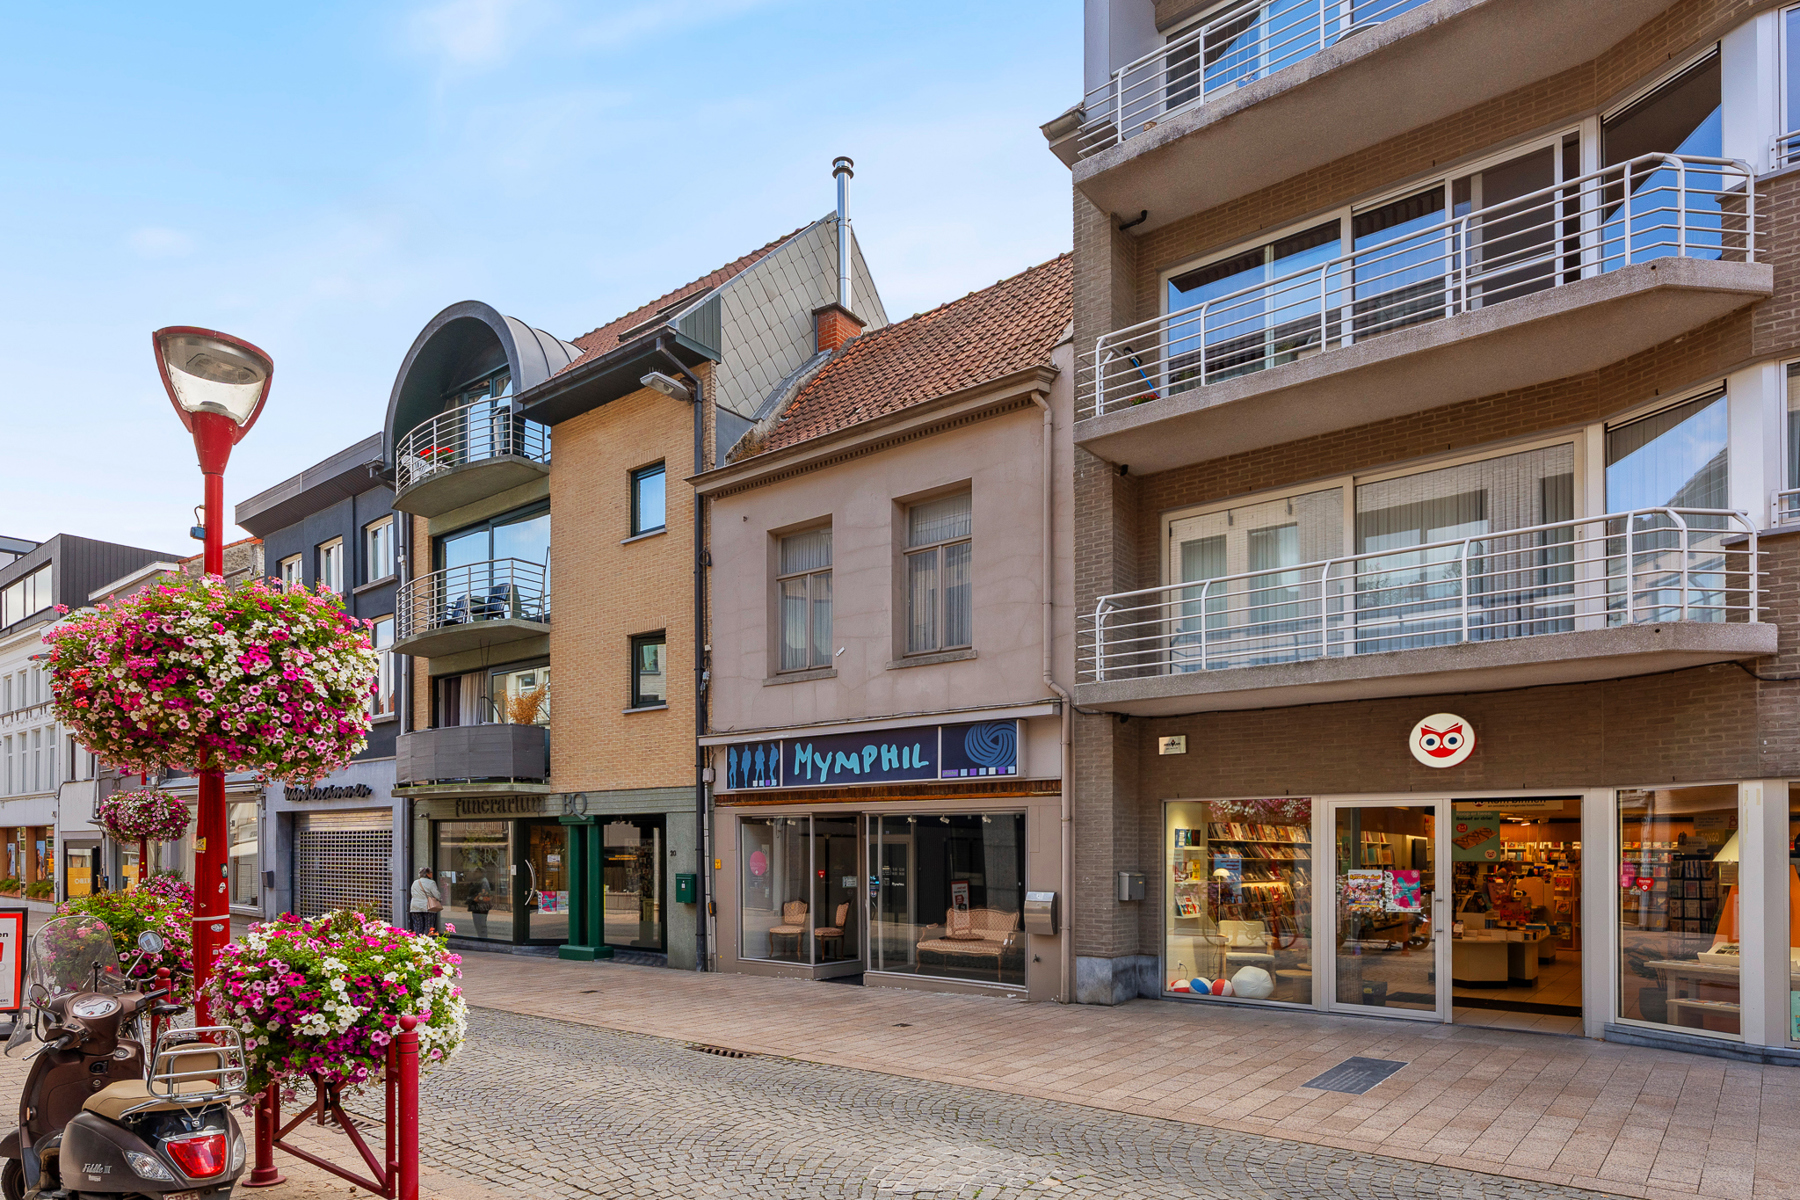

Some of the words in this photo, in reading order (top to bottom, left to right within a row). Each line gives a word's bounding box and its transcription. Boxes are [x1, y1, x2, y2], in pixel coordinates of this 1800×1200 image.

[455, 795, 547, 817] funerarium
[561, 793, 588, 820] BQ
[82, 1163, 104, 1174] Fiddle
